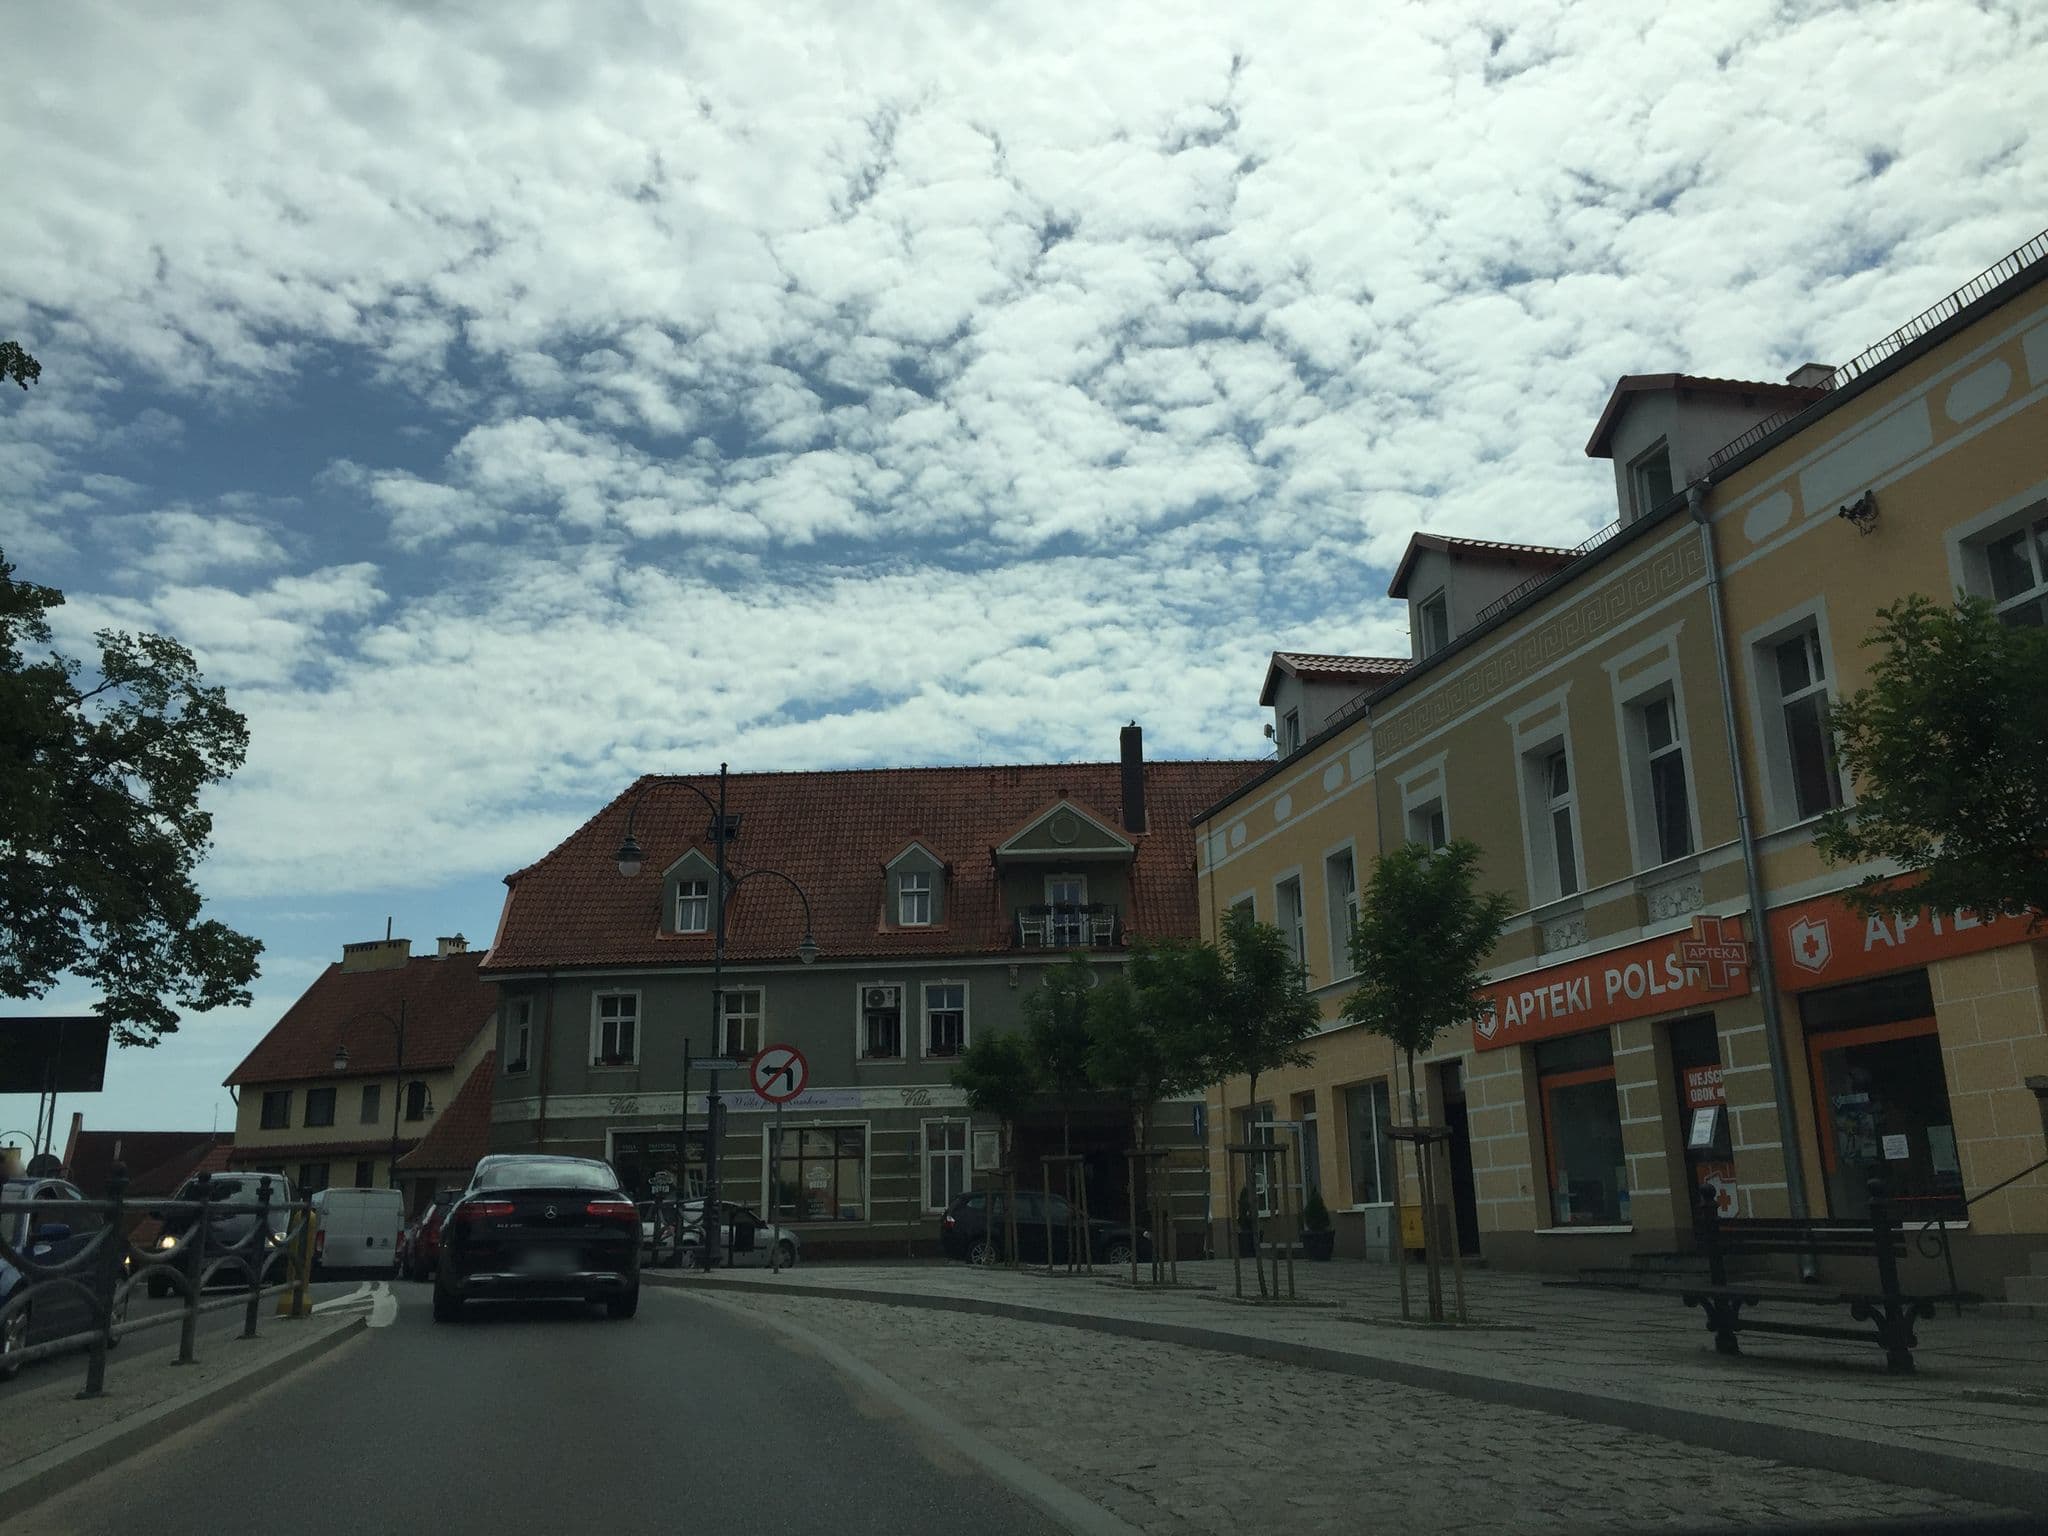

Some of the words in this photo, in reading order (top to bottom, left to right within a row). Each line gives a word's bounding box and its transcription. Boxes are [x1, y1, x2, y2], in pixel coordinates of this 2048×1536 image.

[1689, 947, 1741, 959] APTEKA
[1504, 975, 1592, 1029] APTEKI
[1604, 953, 1740, 1006] POLS
[1688, 1067, 1723, 1087] WEJŚCI
[901, 1088, 931, 1106] Villa
[1690, 1086, 1716, 1102] OBOK
[609, 1095, 640, 1114] Villa
